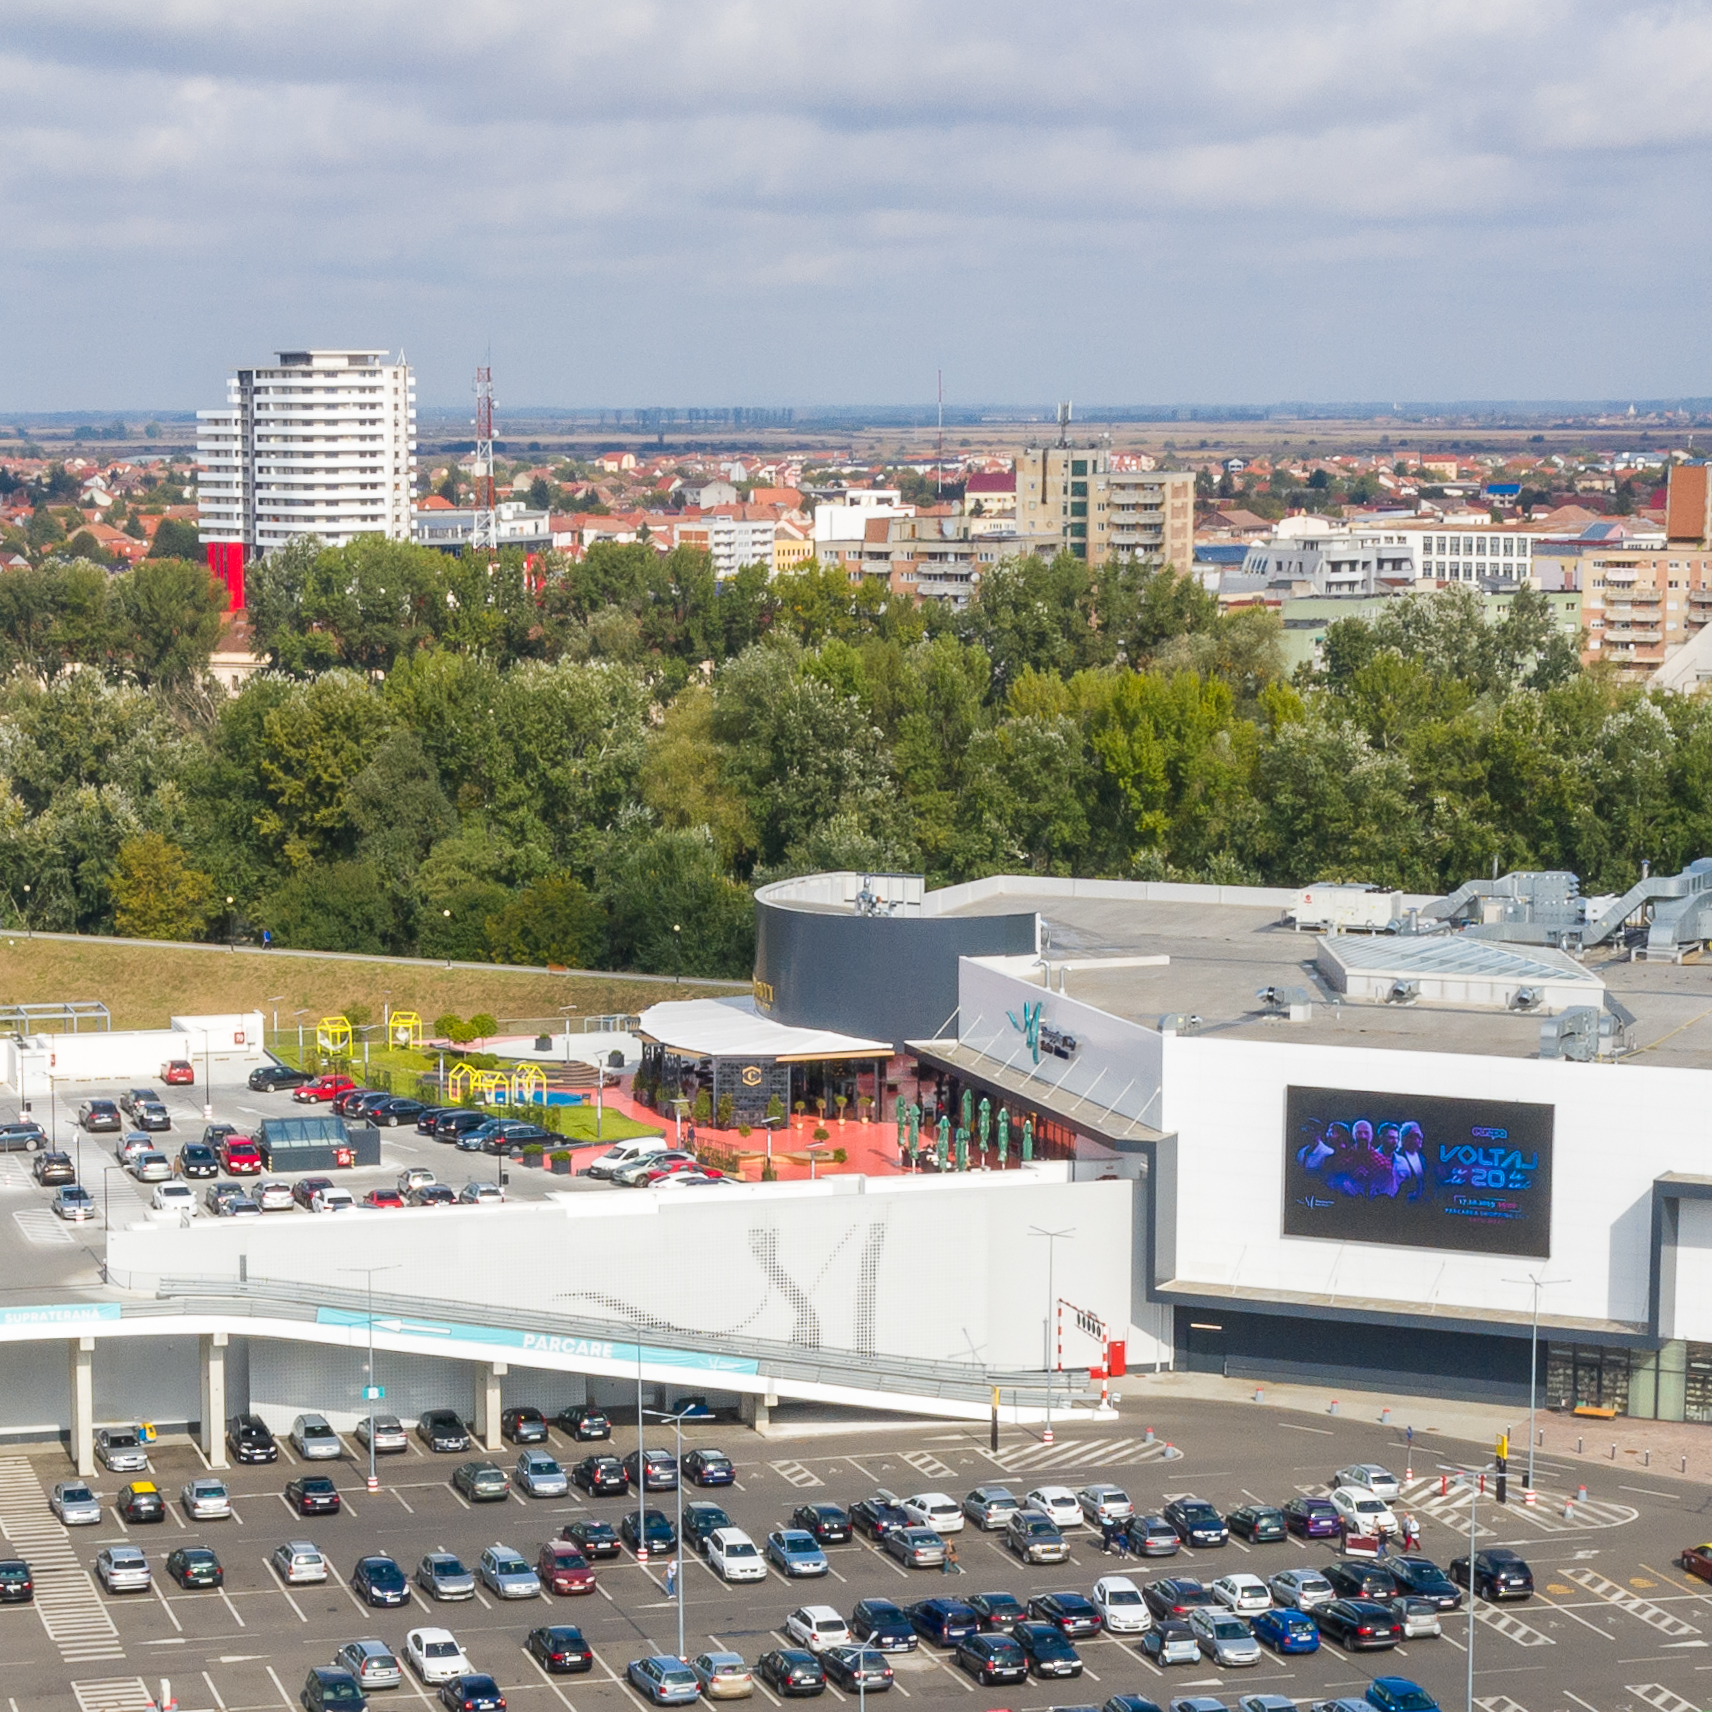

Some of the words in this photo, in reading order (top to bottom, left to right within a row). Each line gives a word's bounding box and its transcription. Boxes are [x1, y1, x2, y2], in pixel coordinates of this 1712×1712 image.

[1439, 1144, 1538, 1170] VOLTAJ
[1471, 1168, 1506, 1188] 20
[522, 1333, 613, 1360] PARCARE
[368, 1387, 379, 1399] B
